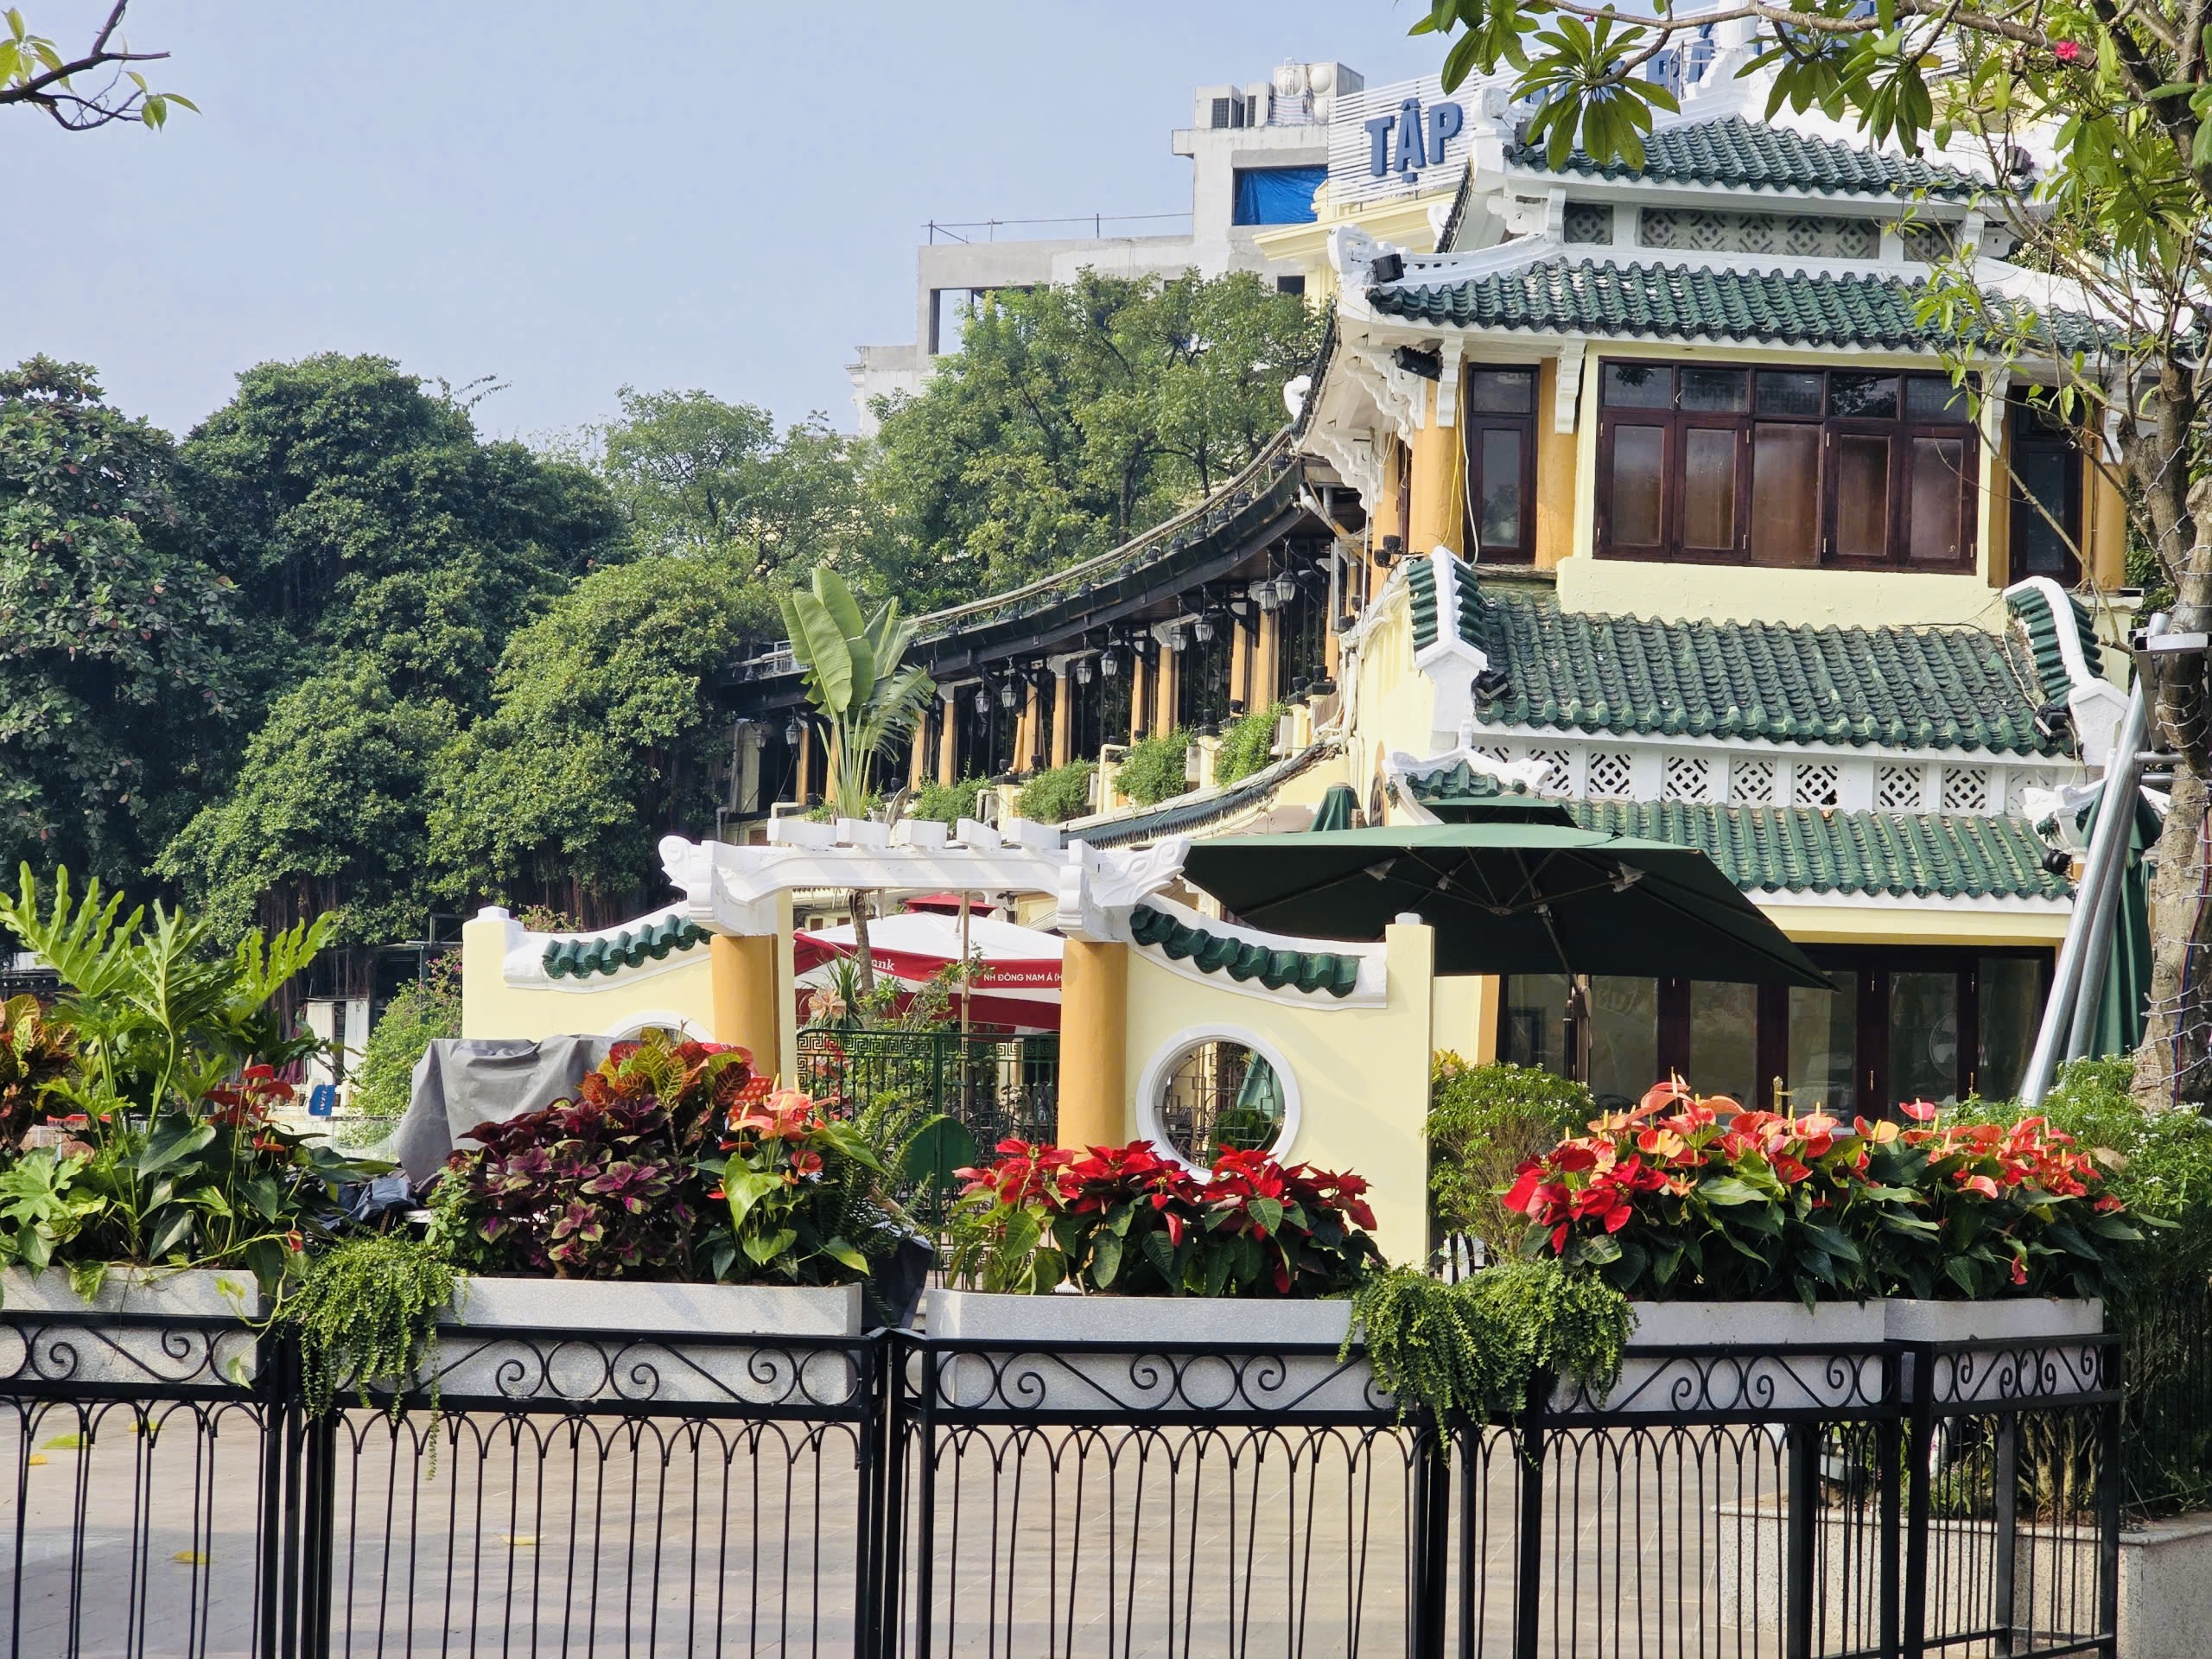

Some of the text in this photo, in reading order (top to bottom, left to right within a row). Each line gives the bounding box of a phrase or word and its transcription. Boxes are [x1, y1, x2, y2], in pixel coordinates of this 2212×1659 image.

[1364, 97, 1463, 183] TẬP
[997, 972, 1025, 982] ĐÔNG
[1026, 973, 1045, 982] NAM
[1046, 971, 1053, 982] Á
